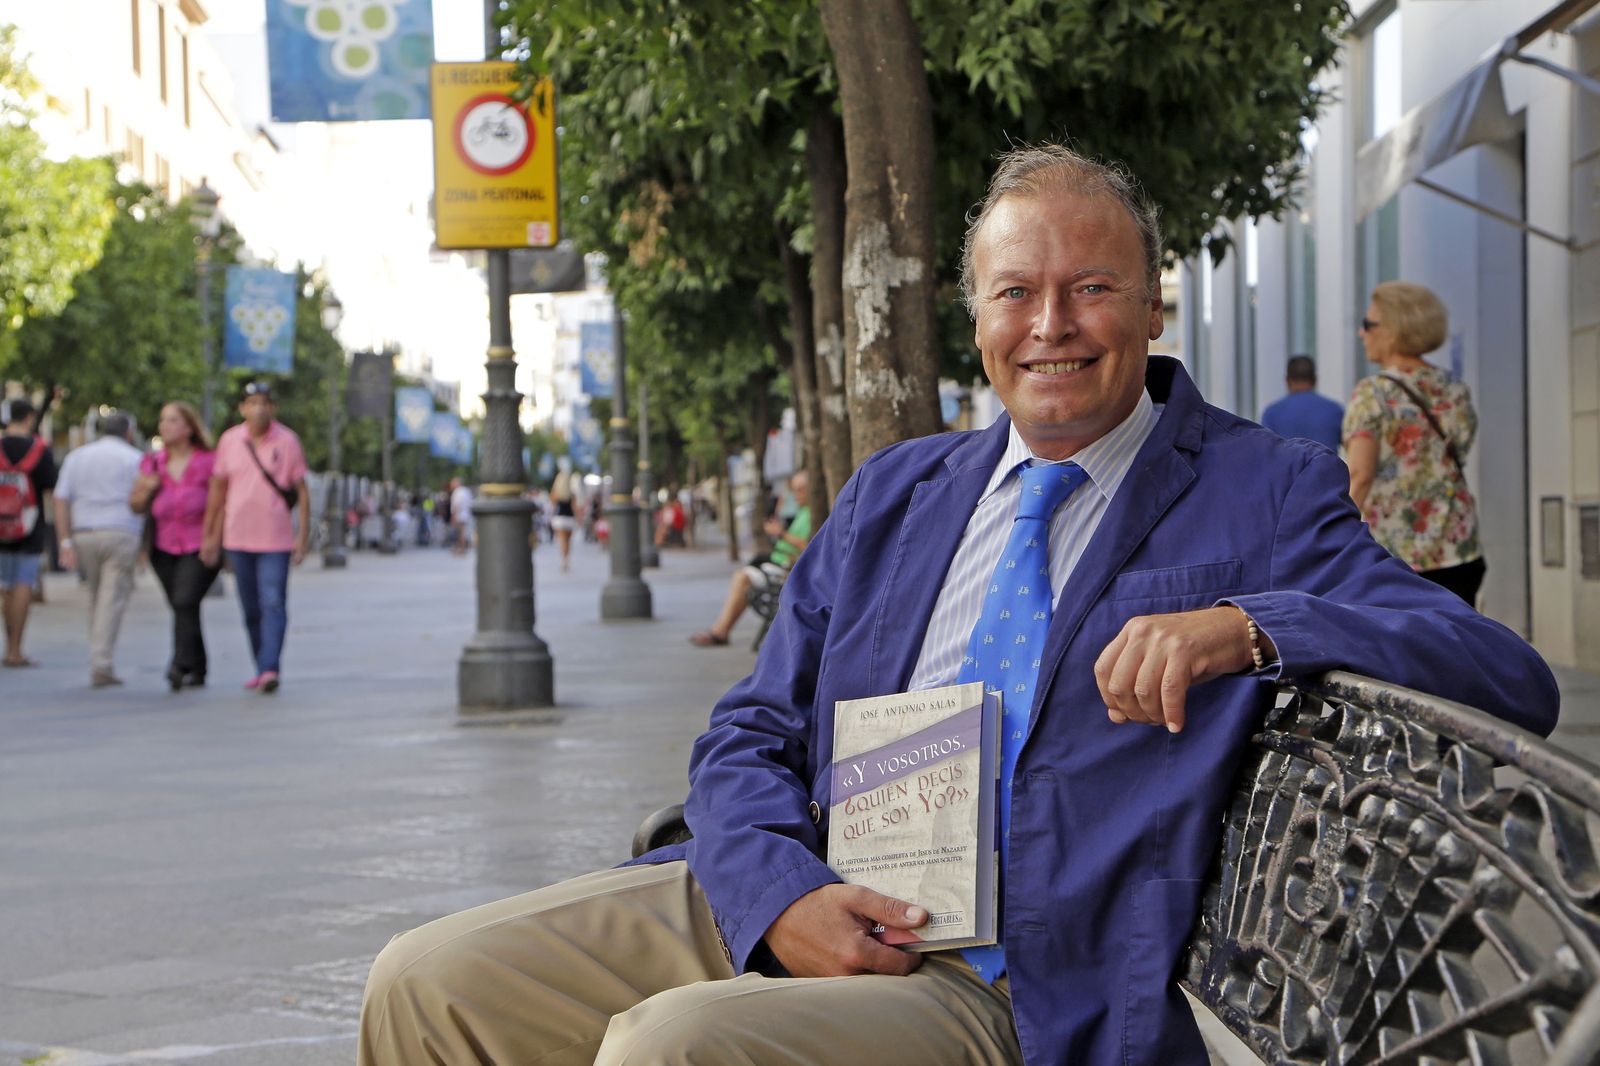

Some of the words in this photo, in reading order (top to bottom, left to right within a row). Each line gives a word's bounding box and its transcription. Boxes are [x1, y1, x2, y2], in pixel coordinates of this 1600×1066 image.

[884, 703, 926, 716] ANTONIO
[930, 698, 956, 710] SALAS
[918, 762, 963, 790] DECÍS
[843, 817, 875, 840] QUE
[882, 804, 911, 828] SOY
